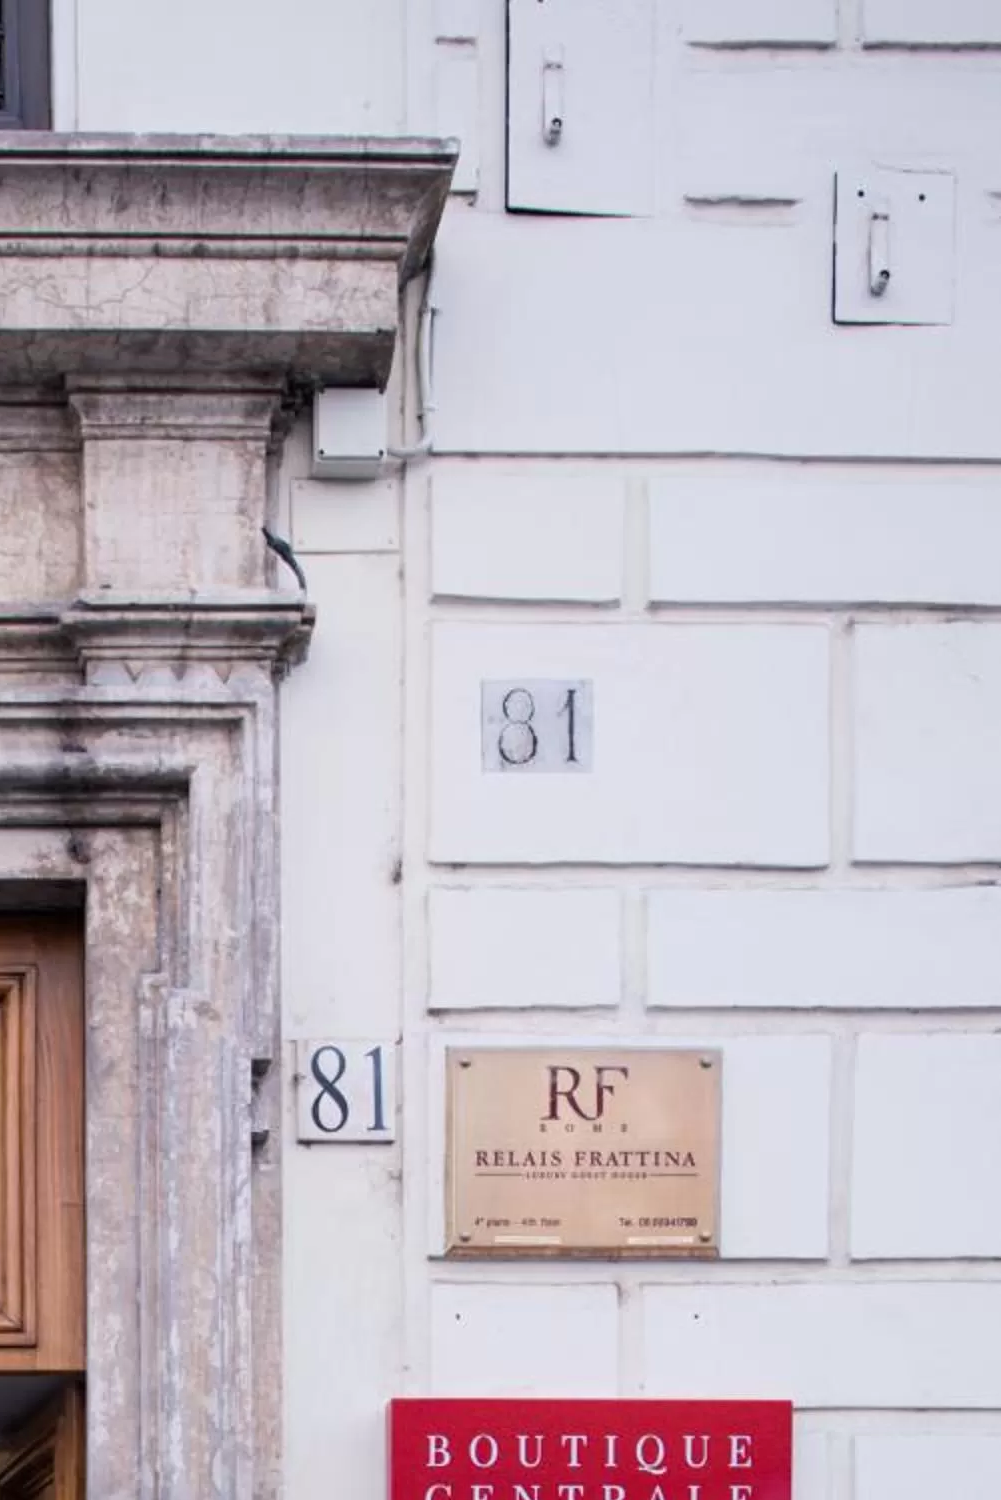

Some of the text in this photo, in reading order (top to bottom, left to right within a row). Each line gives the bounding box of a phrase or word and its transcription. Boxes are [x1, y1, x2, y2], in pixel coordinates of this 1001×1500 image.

[498, 687, 578, 764] 81
[310, 1044, 391, 1133] 81
[540, 1066, 629, 1121] RF
[475, 1150, 697, 1168] RELAIS FRATTINA
[427, 1434, 753, 1475] BOUTIQUE
